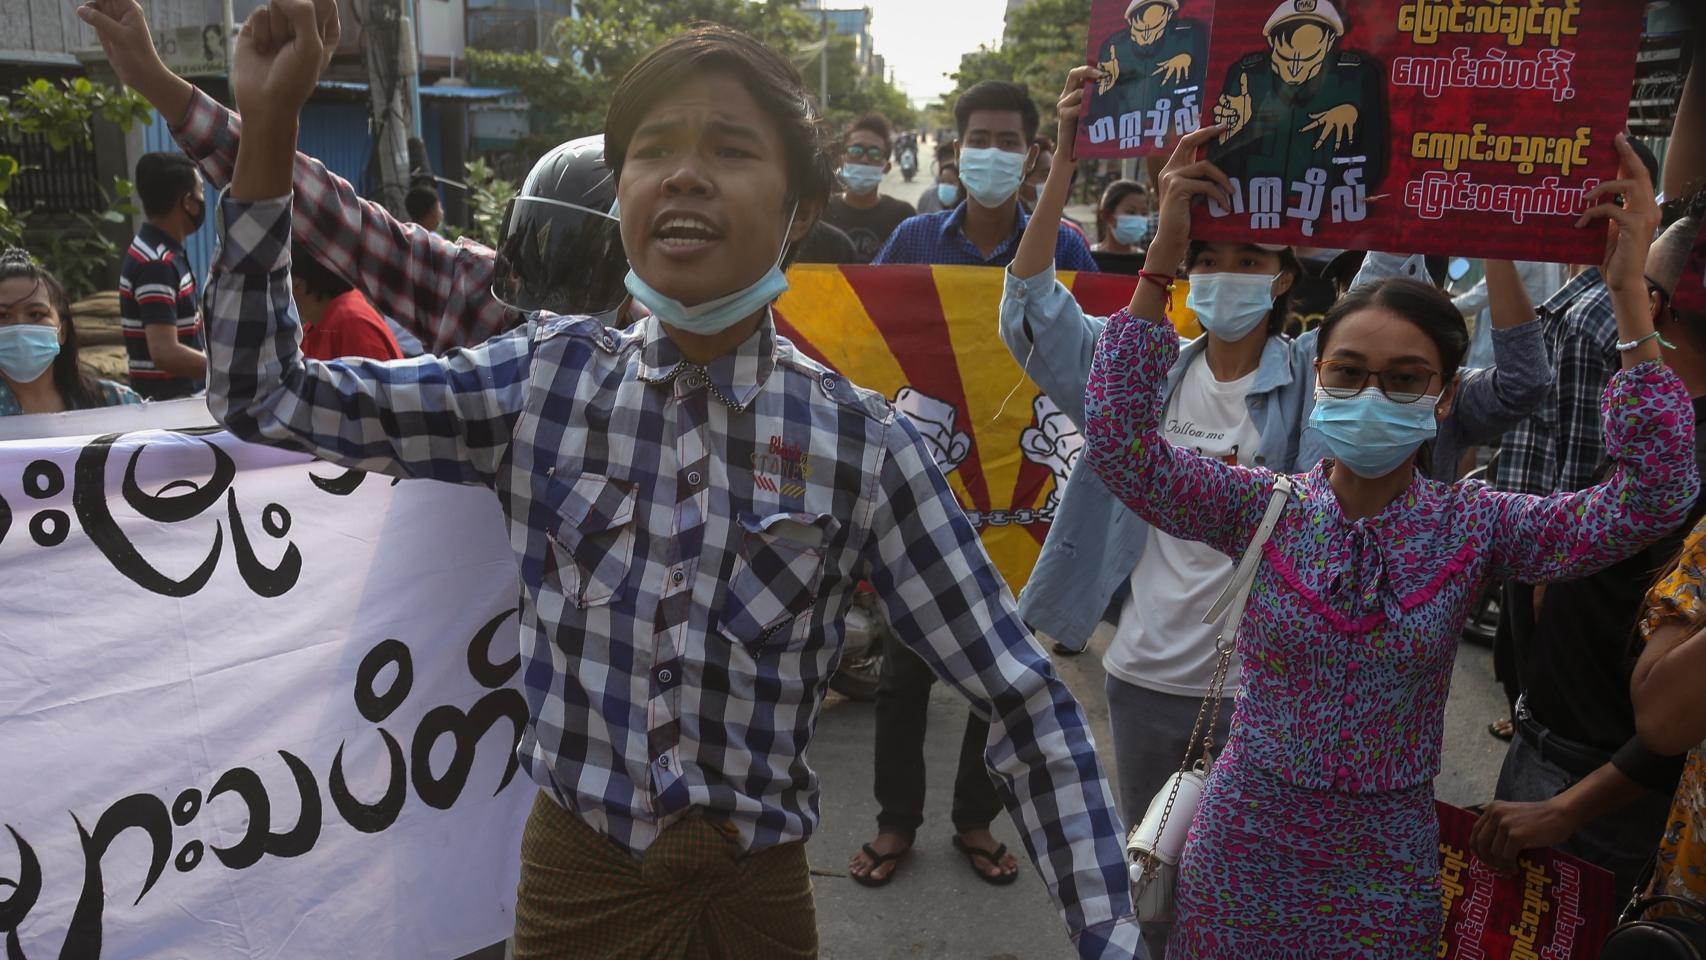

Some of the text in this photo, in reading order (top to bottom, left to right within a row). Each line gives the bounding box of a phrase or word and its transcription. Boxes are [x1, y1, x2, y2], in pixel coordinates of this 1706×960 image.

[1412, 123, 1591, 176] ကျောင်းဝသွားရင်
[1165, 420, 1225, 440] Follow me
